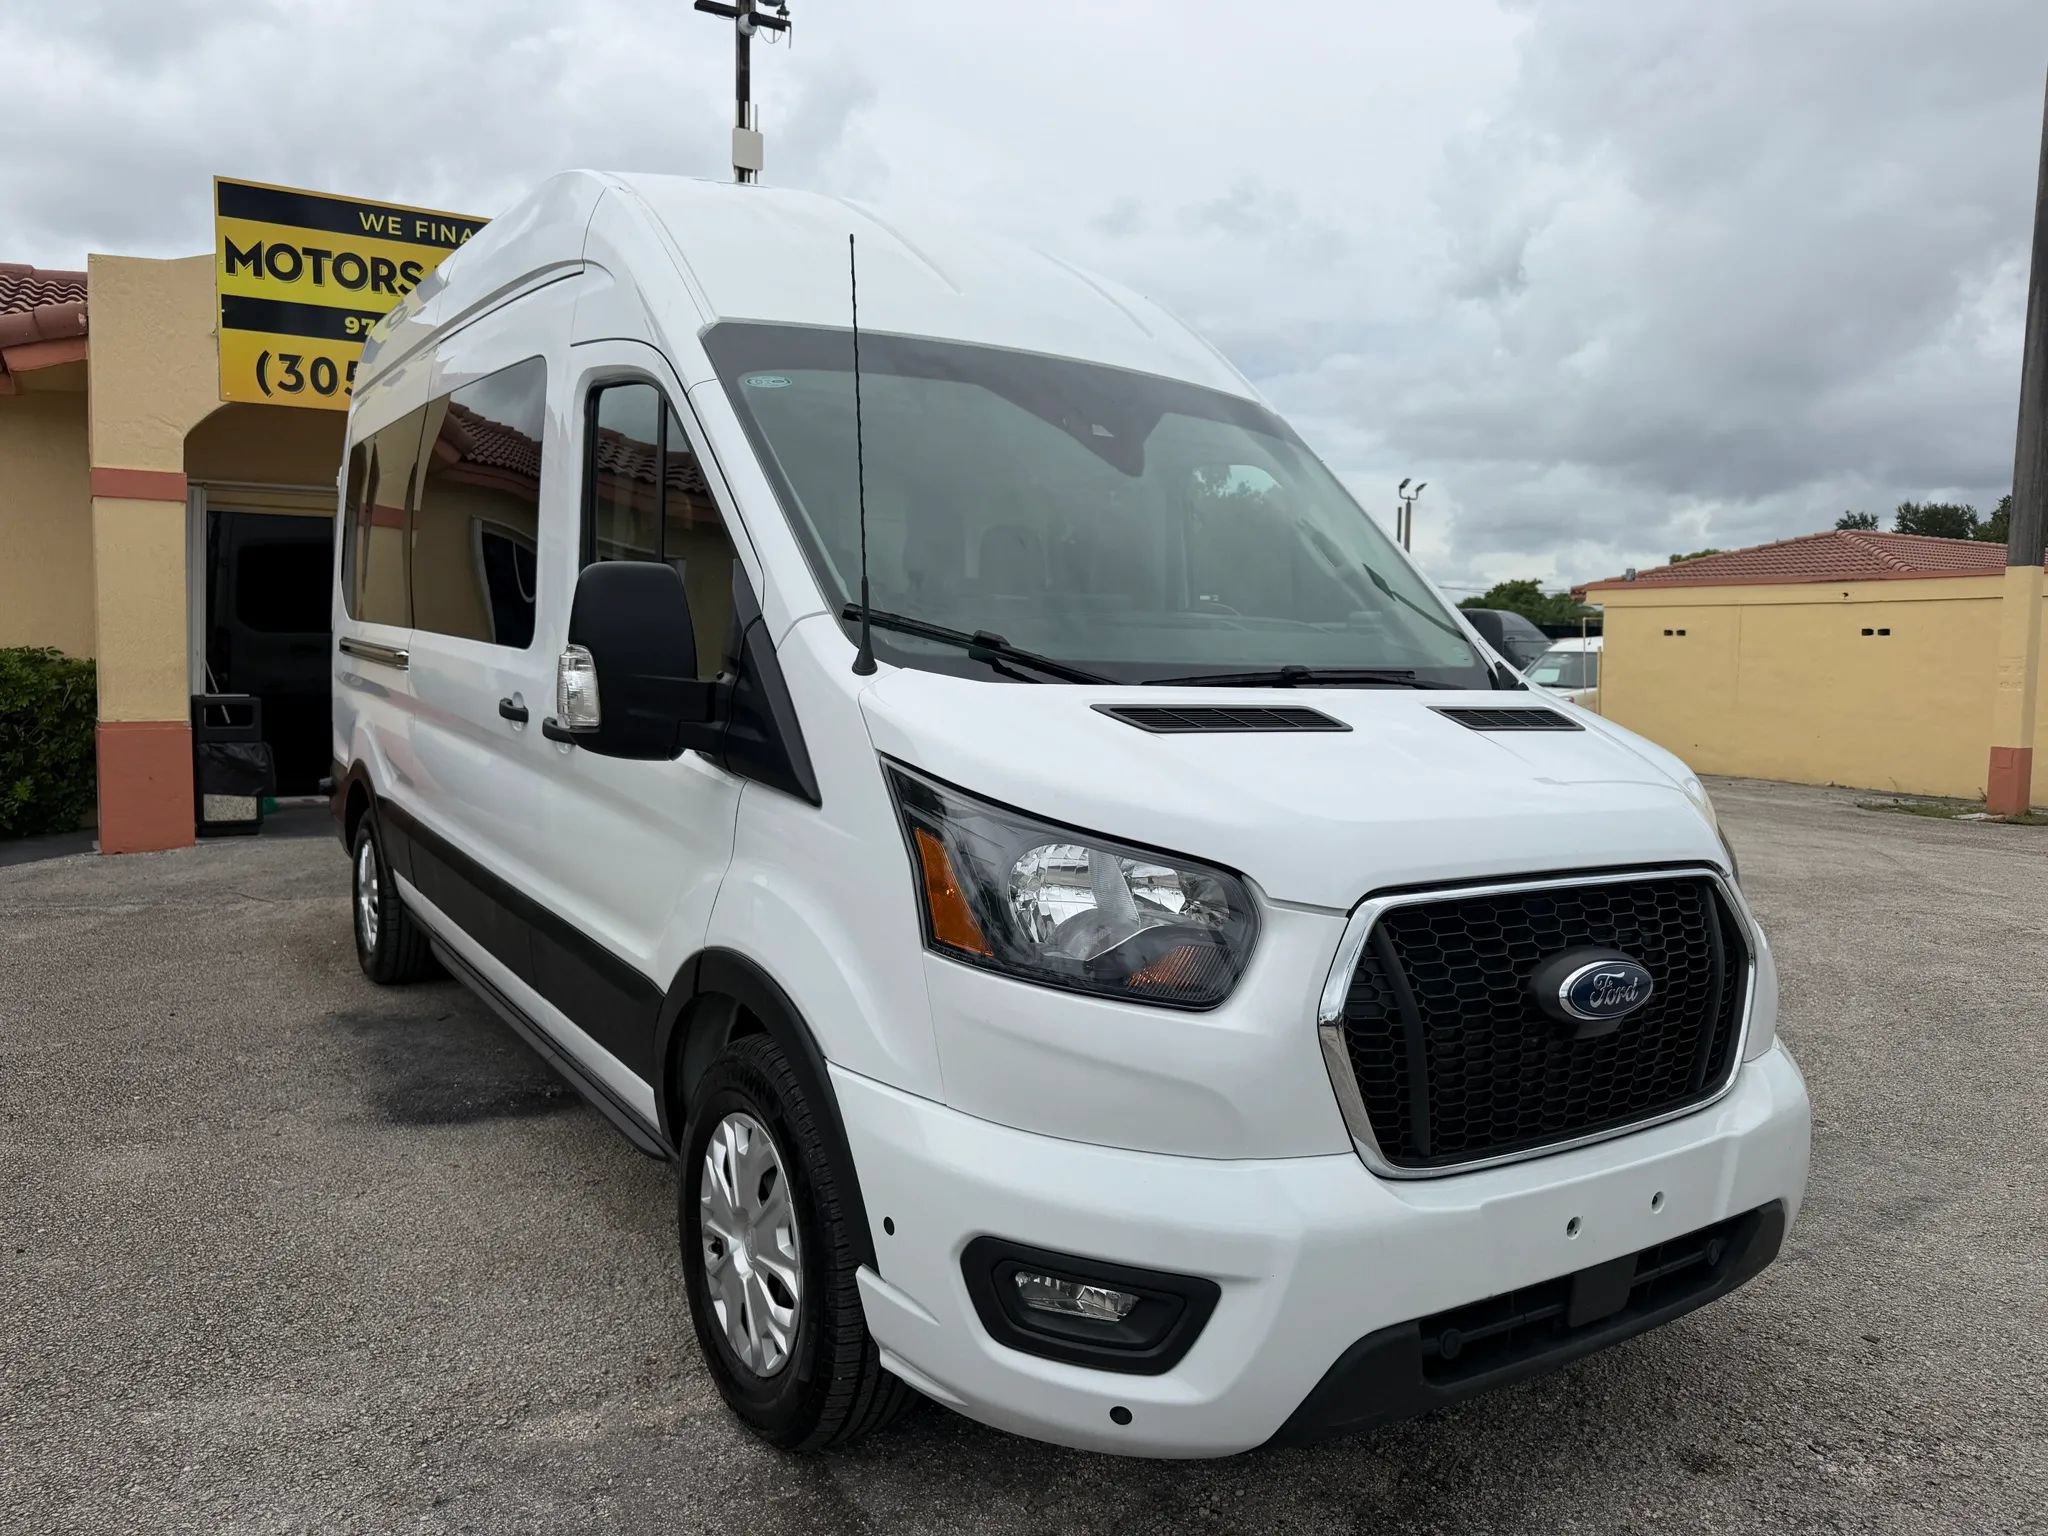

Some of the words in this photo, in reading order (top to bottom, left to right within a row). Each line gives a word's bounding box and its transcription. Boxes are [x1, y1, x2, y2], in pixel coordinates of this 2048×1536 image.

[359, 211, 402, 235] WE
[415, 220, 473, 244] FINA
[224, 235, 424, 297] MOTORS
[344, 316, 376, 336] 97
[1589, 971, 1639, 1008] Ford
